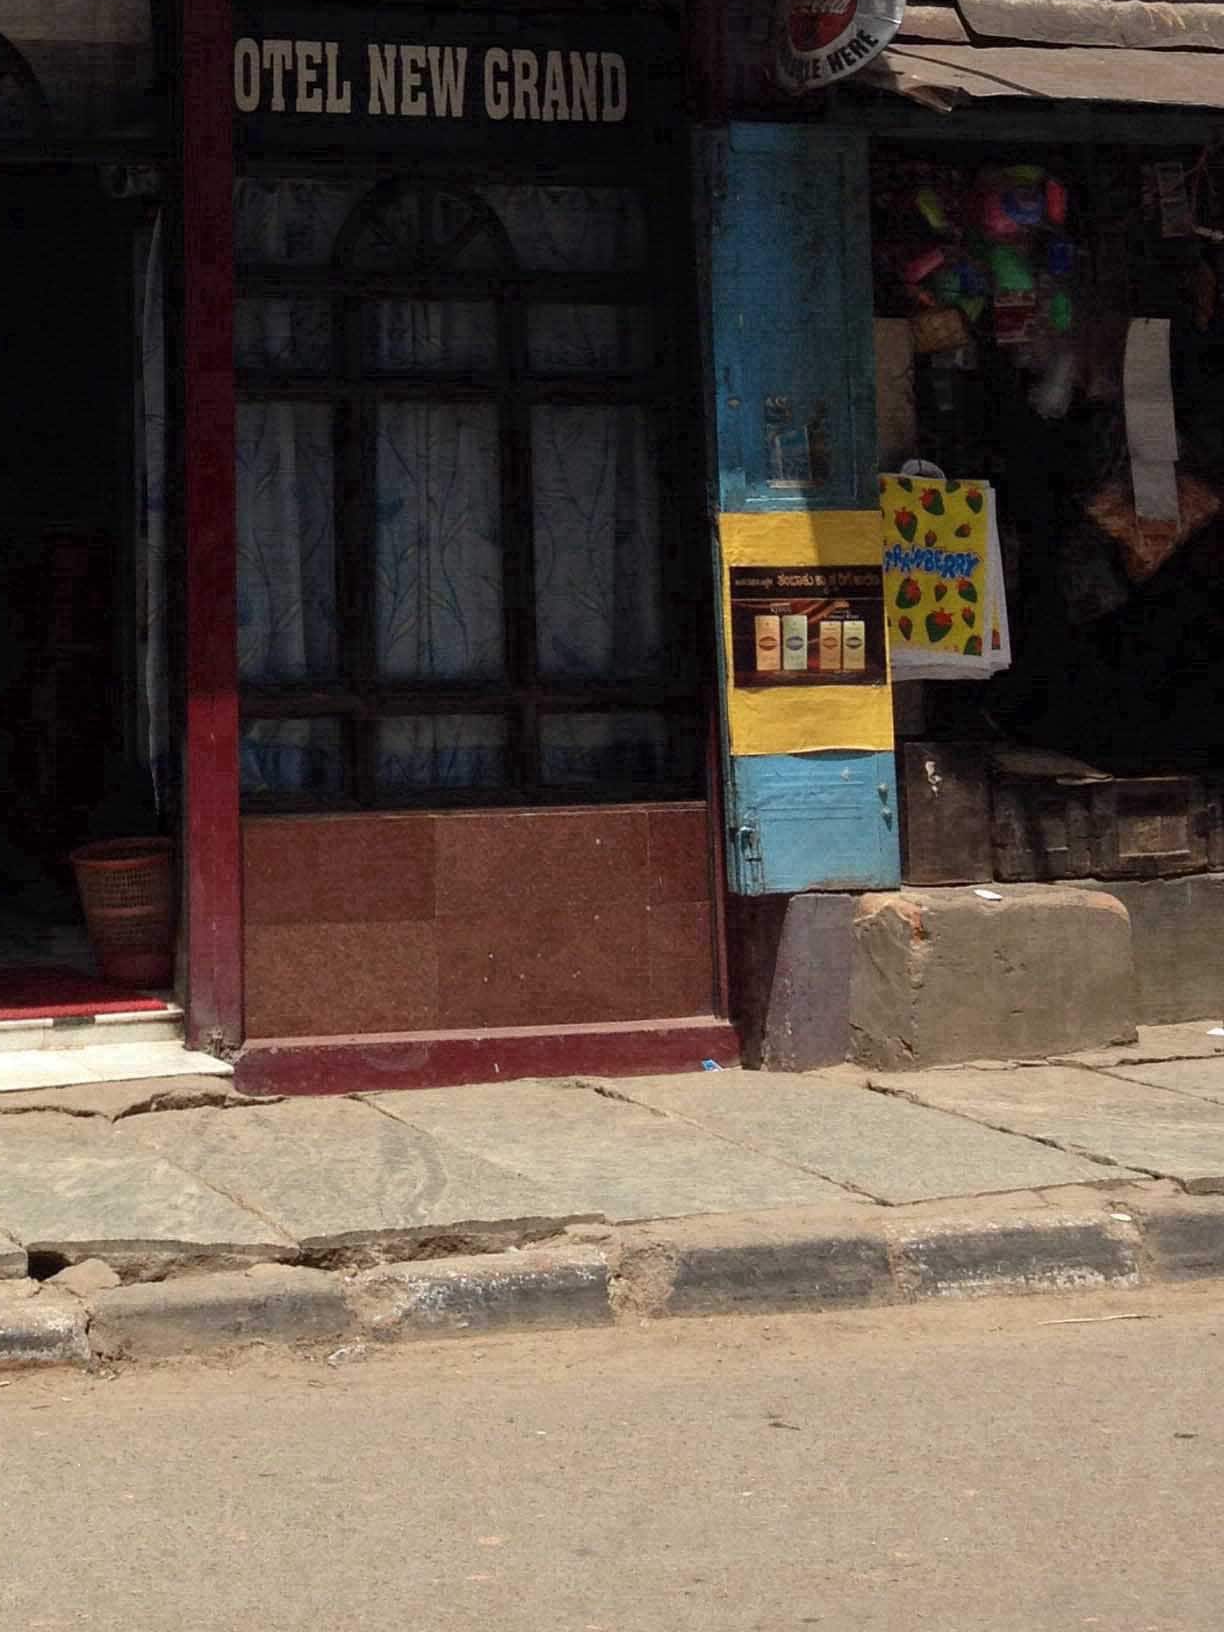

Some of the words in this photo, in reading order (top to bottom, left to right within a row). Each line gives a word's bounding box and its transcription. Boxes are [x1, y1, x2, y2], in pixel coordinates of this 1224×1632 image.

[232, 37, 352, 115] OTEL
[367, 43, 468, 118] NEW
[483, 46, 628, 122] GRAND
[826, 29, 879, 74] HERE
